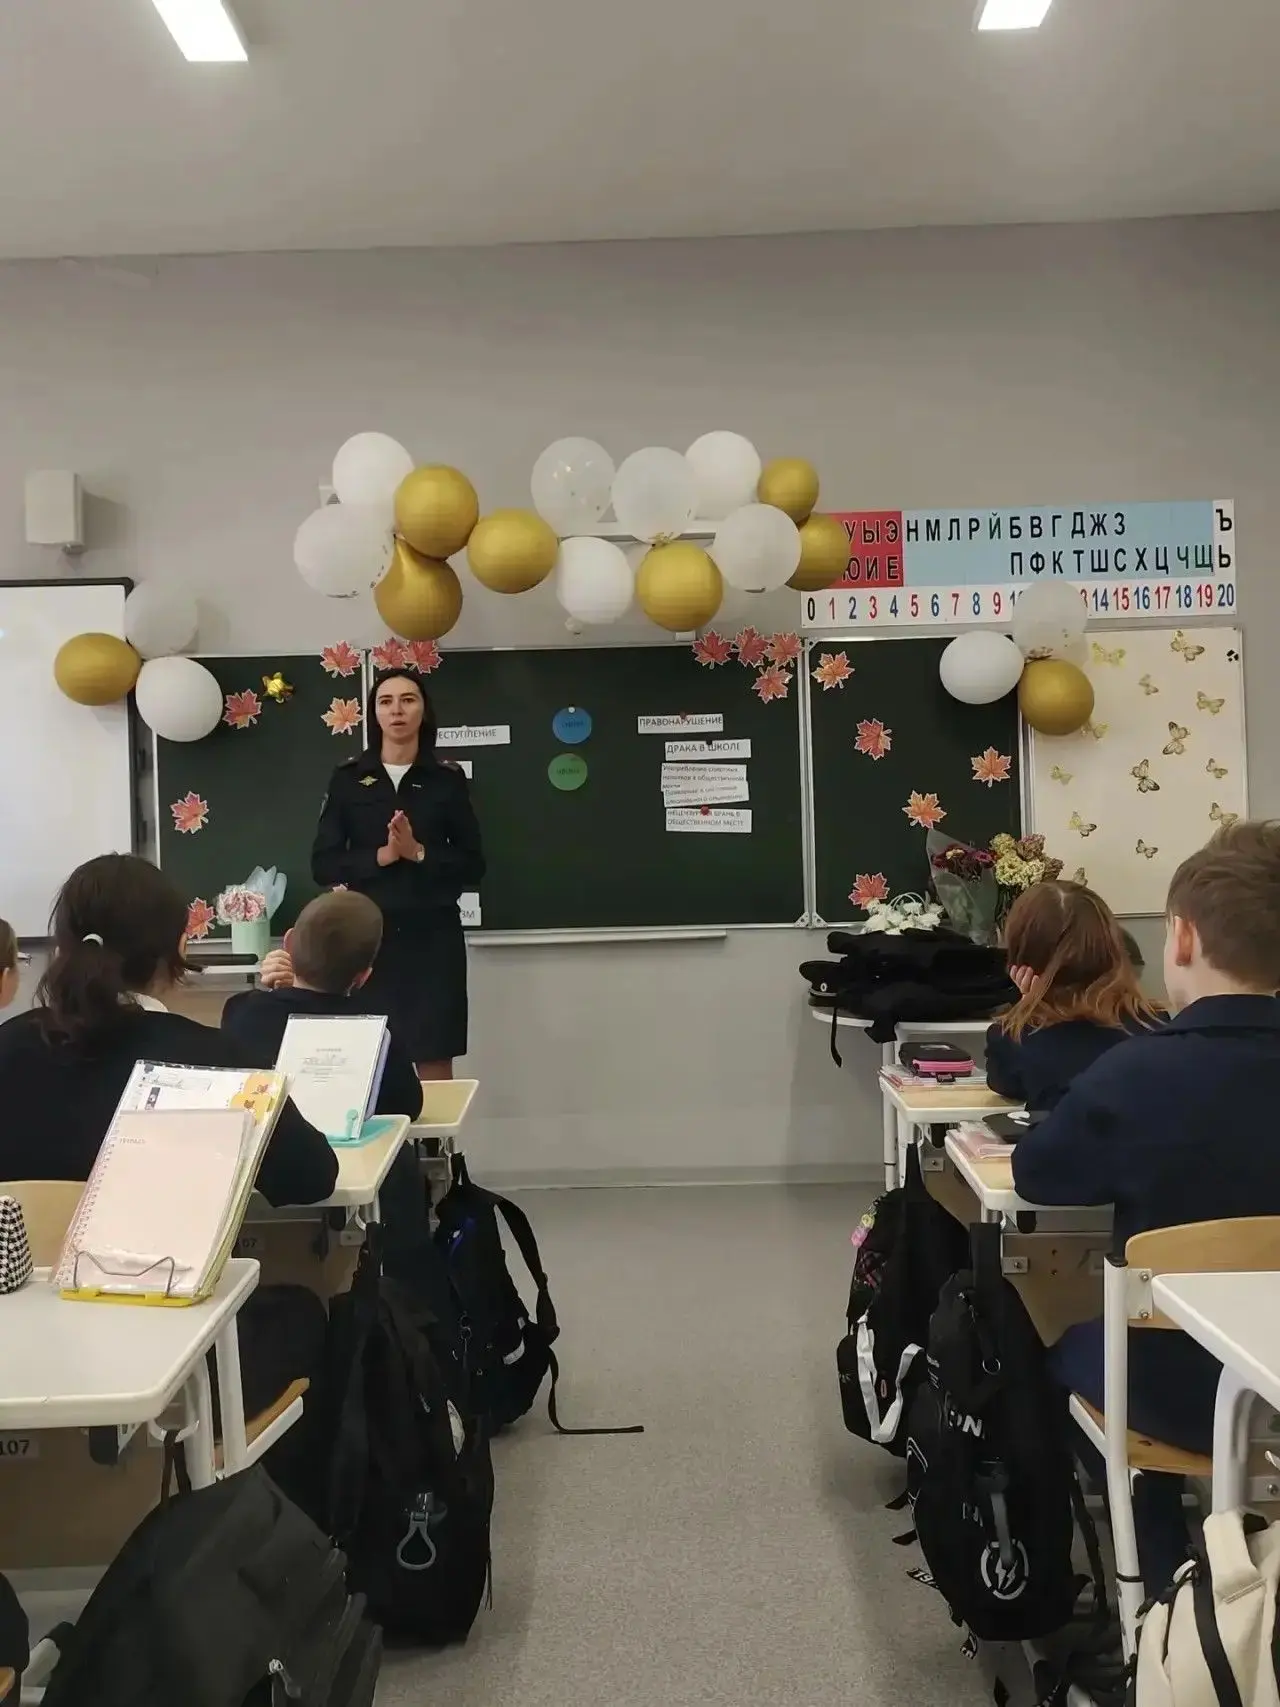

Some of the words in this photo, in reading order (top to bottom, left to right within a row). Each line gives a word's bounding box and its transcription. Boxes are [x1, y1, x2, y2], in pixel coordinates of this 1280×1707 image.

[808, 598, 815, 621] 0
[829, 597, 835, 620] 1
[849, 596, 857, 619] 2
[869, 596, 877, 619] 3
[890, 595, 898, 618] 4
[911, 594, 918, 617] 5
[931, 593, 939, 617] 6
[952, 593, 959, 616] 7
[973, 592, 980, 615] 8
[993, 592, 1001, 615] 9
[1092, 587, 1109, 611] 14
[1113, 587, 1130, 610] 15
[1134, 586, 1150, 609] 16
[1155, 586, 1171, 609] 17
[1176, 585, 1192, 608] 18
[1196, 584, 1213, 607] 19
[1217, 583, 1234, 606] 20
[640, 717, 723, 728] ПРАВОНАРУШЕНИЕ
[438, 728, 497, 740] ЕСТУПЛЕНИЕ
[667, 744, 697, 753] ДРАКА
[700, 744, 705, 752] В
[708, 742, 740, 752] ШКОЛЕ
